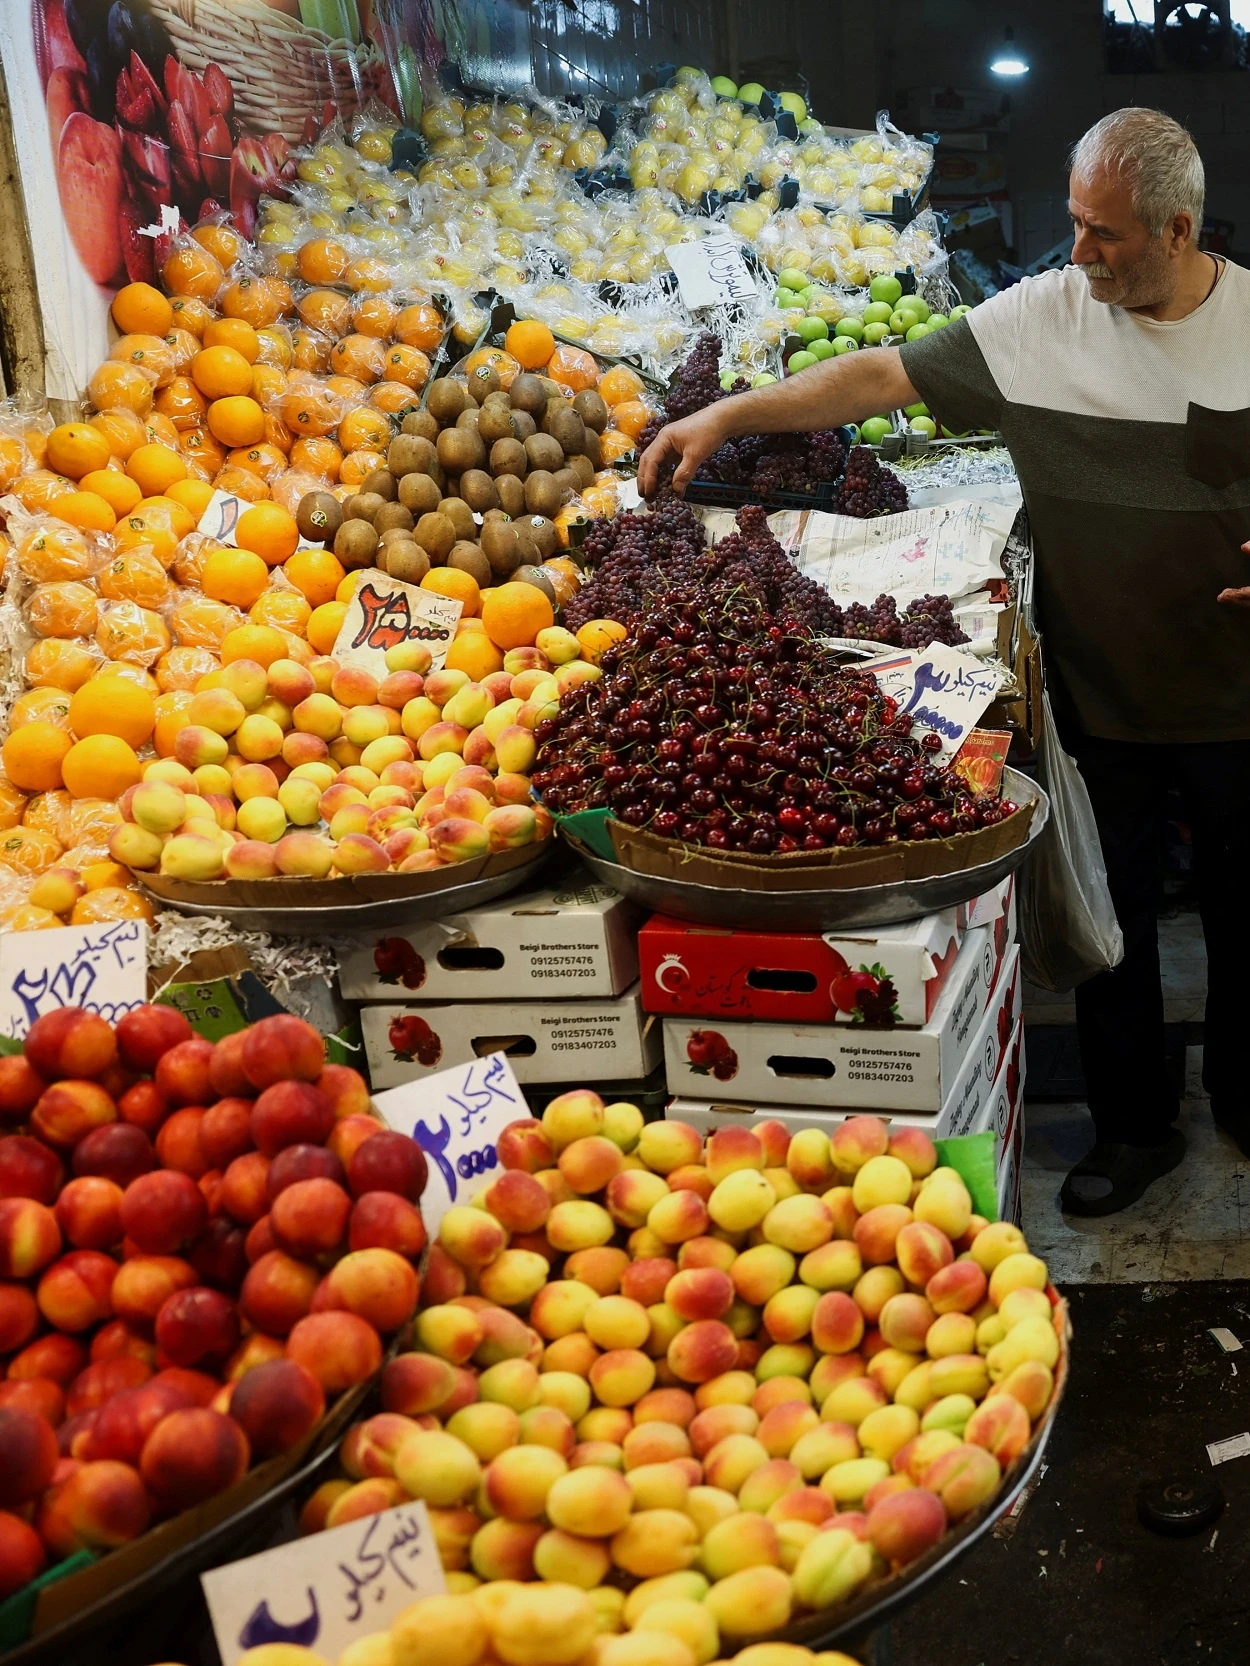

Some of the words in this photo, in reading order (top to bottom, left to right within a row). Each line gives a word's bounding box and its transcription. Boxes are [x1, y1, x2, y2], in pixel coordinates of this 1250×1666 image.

[520, 943, 540, 953] Beigi
[541, 943, 577, 951] Brothers
[530, 956, 594, 965] 09125757476
[531, 969, 596, 978] 09183407203
[541, 1016, 562, 1026] Beigi
[562, 1016, 597, 1024] Brothers
[551, 1028, 614, 1039] 09125757476
[551, 1040, 617, 1051] 09183407203
[840, 1047, 861, 1057] Beigi
[862, 1048, 897, 1057] Brothers
[849, 1060, 912, 1071] 09125757476
[848, 1071, 914, 1082] 09183407203
